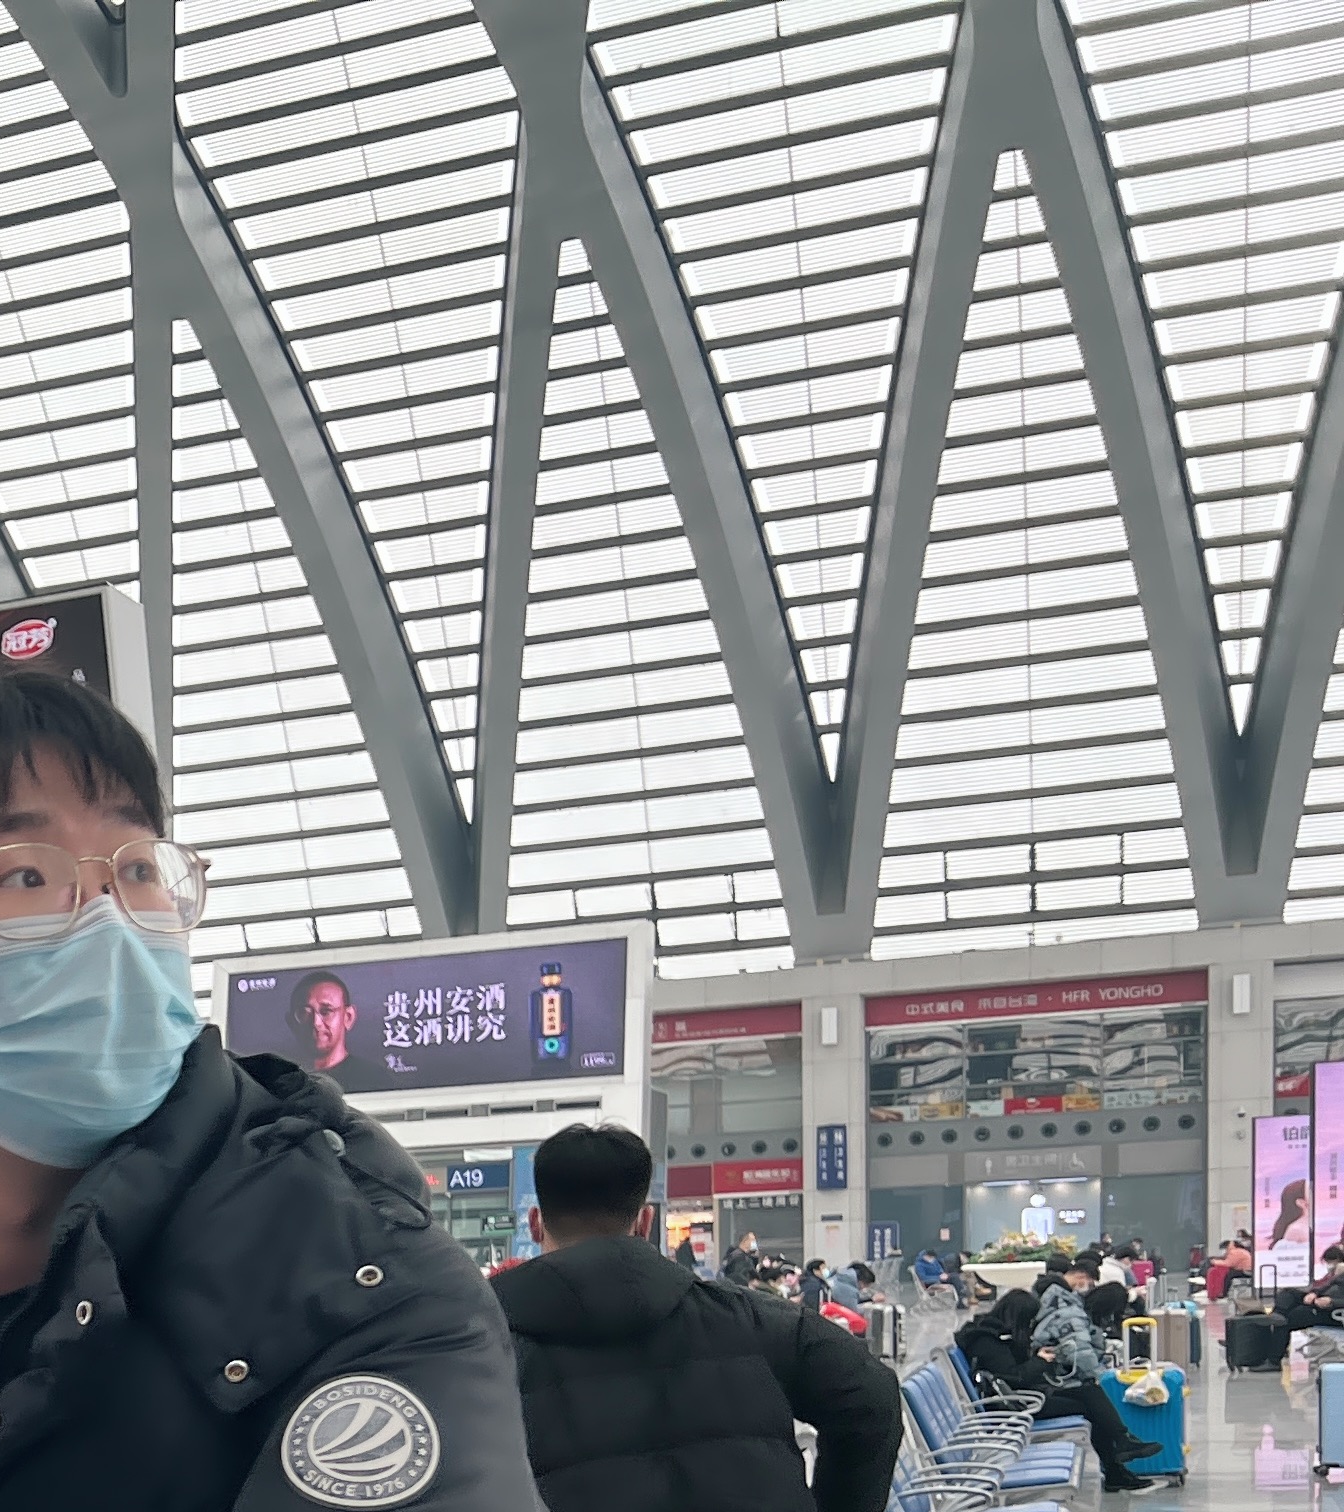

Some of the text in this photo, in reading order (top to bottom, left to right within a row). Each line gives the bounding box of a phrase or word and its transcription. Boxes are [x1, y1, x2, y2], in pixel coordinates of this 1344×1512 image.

[383, 982, 506, 1021] 贵州安酒
[383, 1012, 508, 1049] 这酒讲究
[449, 1168, 484, 1189] A19
[312, 1384, 419, 1418] BOSIDENG
[303, 1469, 407, 1498] SINCE 1976
